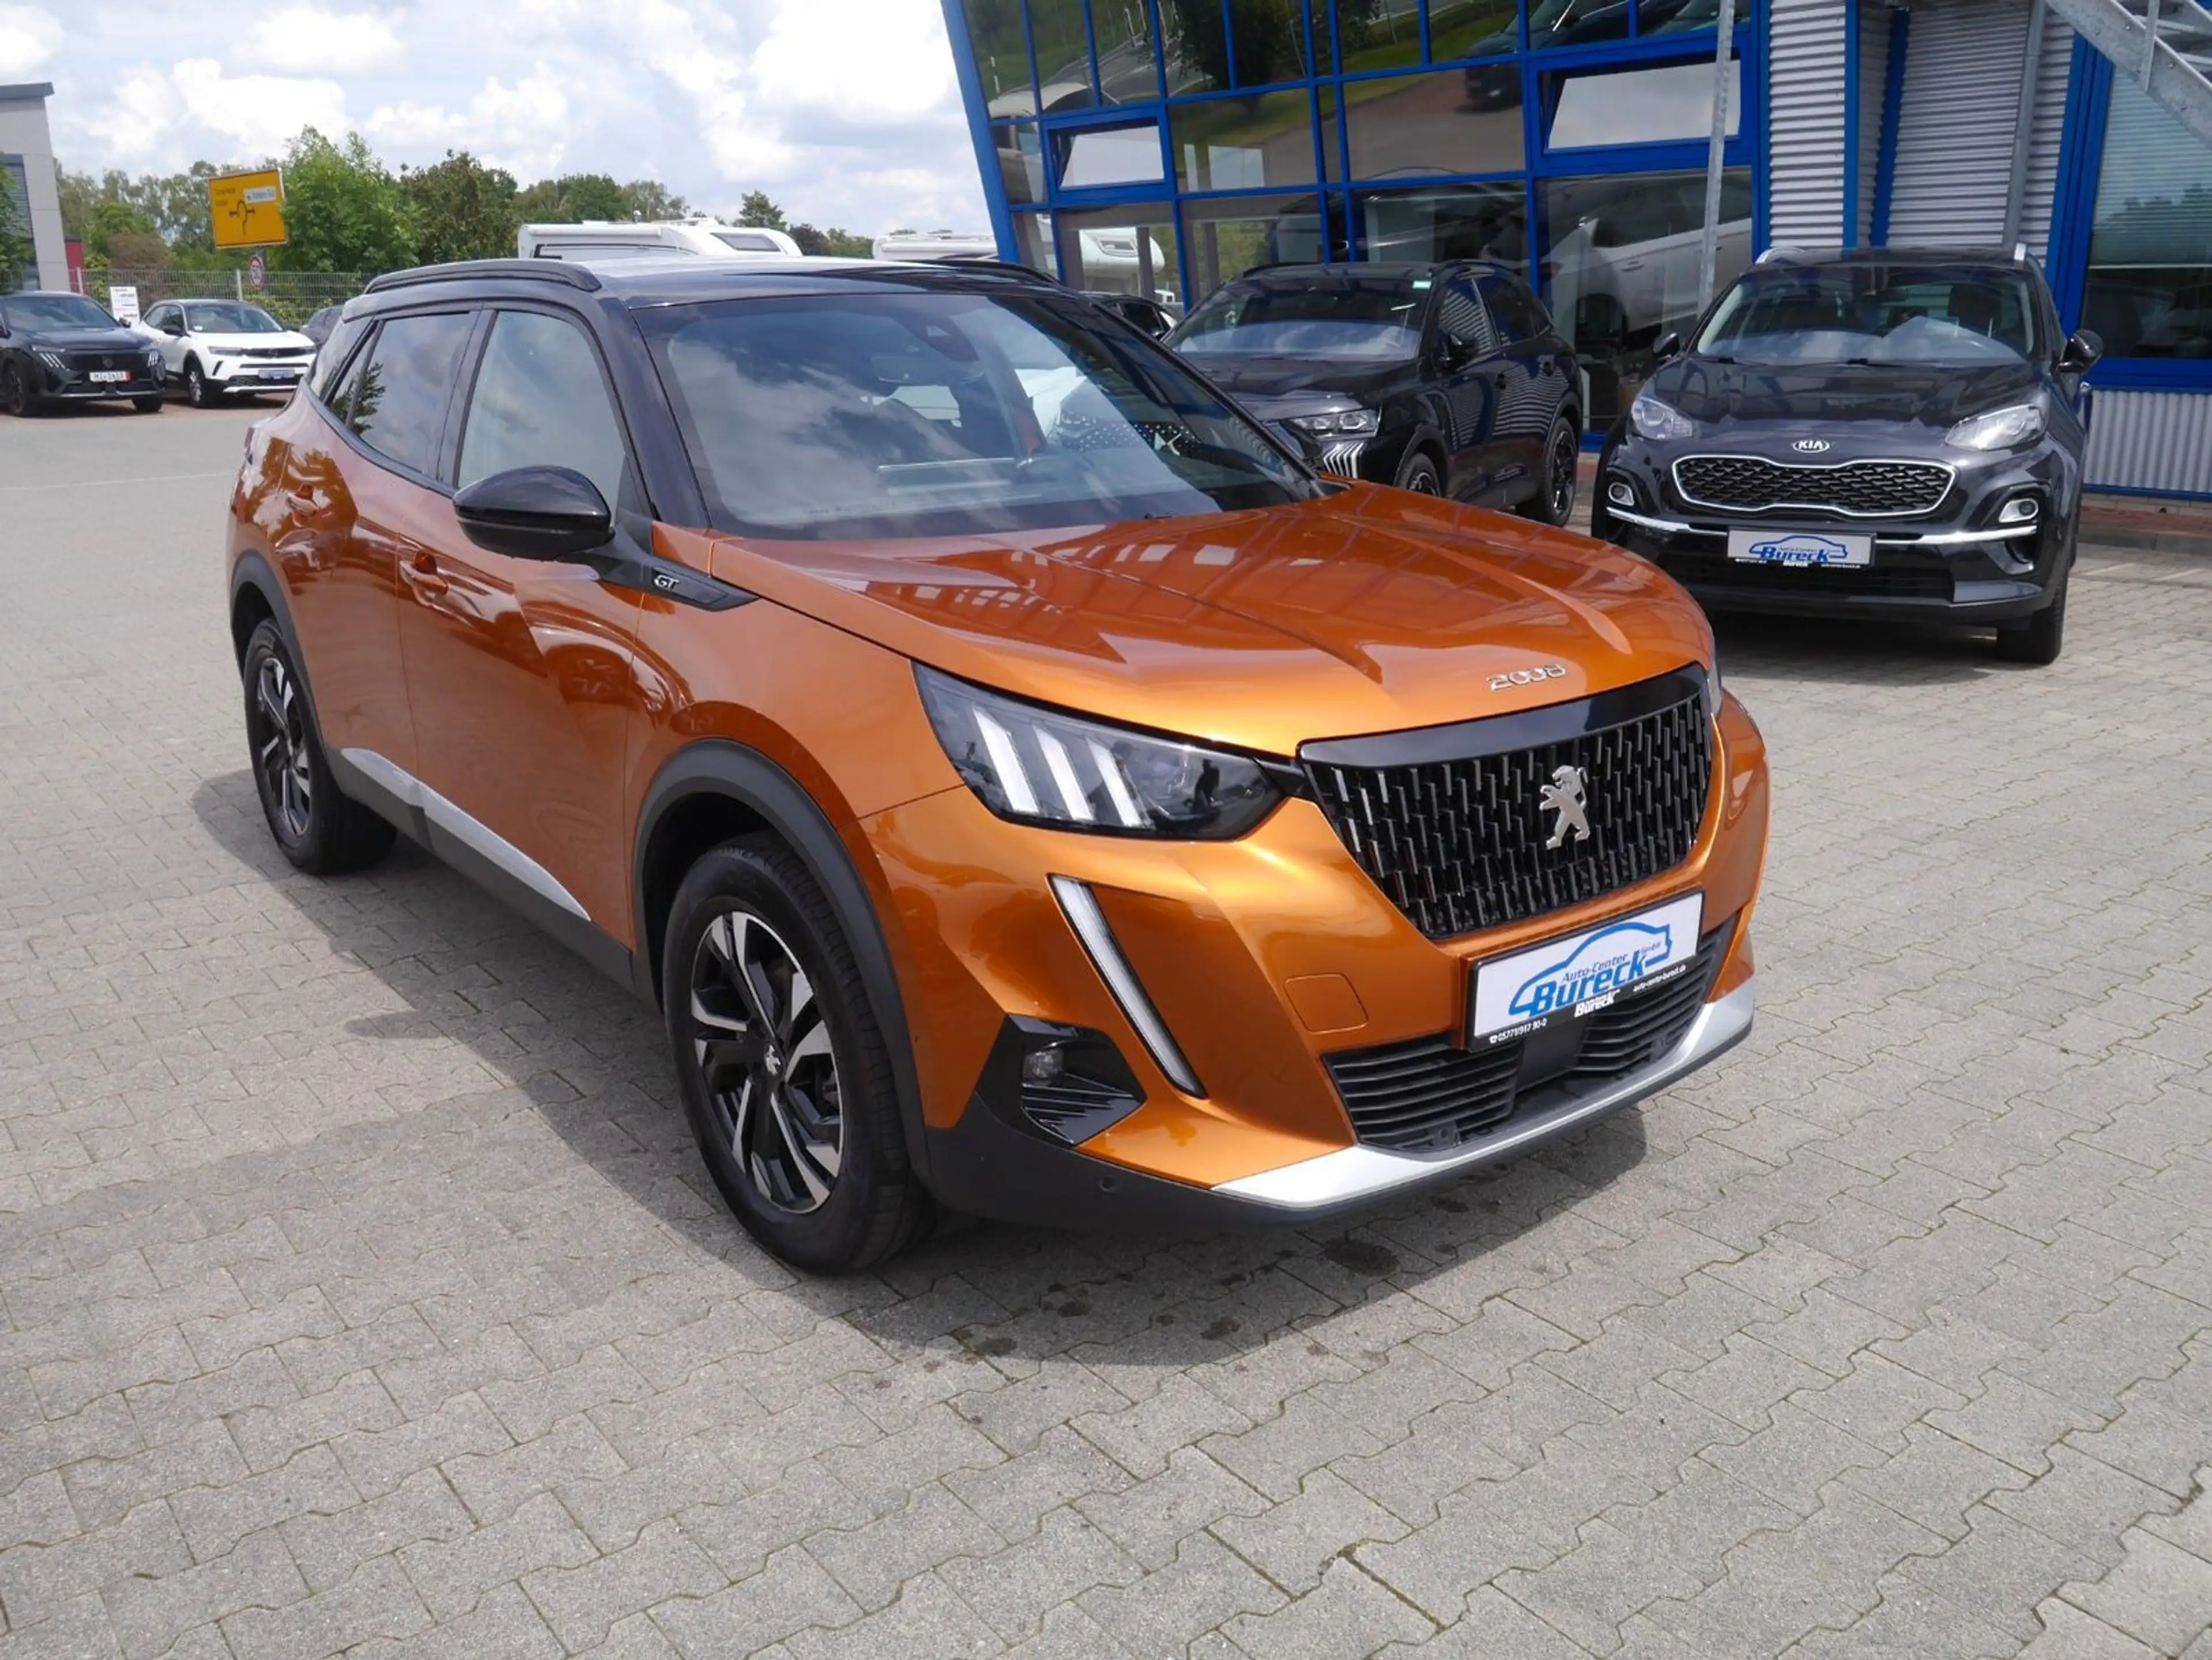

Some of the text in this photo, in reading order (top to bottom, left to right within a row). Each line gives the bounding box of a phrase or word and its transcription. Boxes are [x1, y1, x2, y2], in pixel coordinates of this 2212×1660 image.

[1798, 440, 1823, 450] KIA
[1759, 546, 1829, 562] Bureck
[654, 575, 680, 589] GT
[1486, 663, 1566, 691] 2008
[1563, 953, 1629, 982] Auto-Center
[1528, 949, 1646, 1017] Bureck
